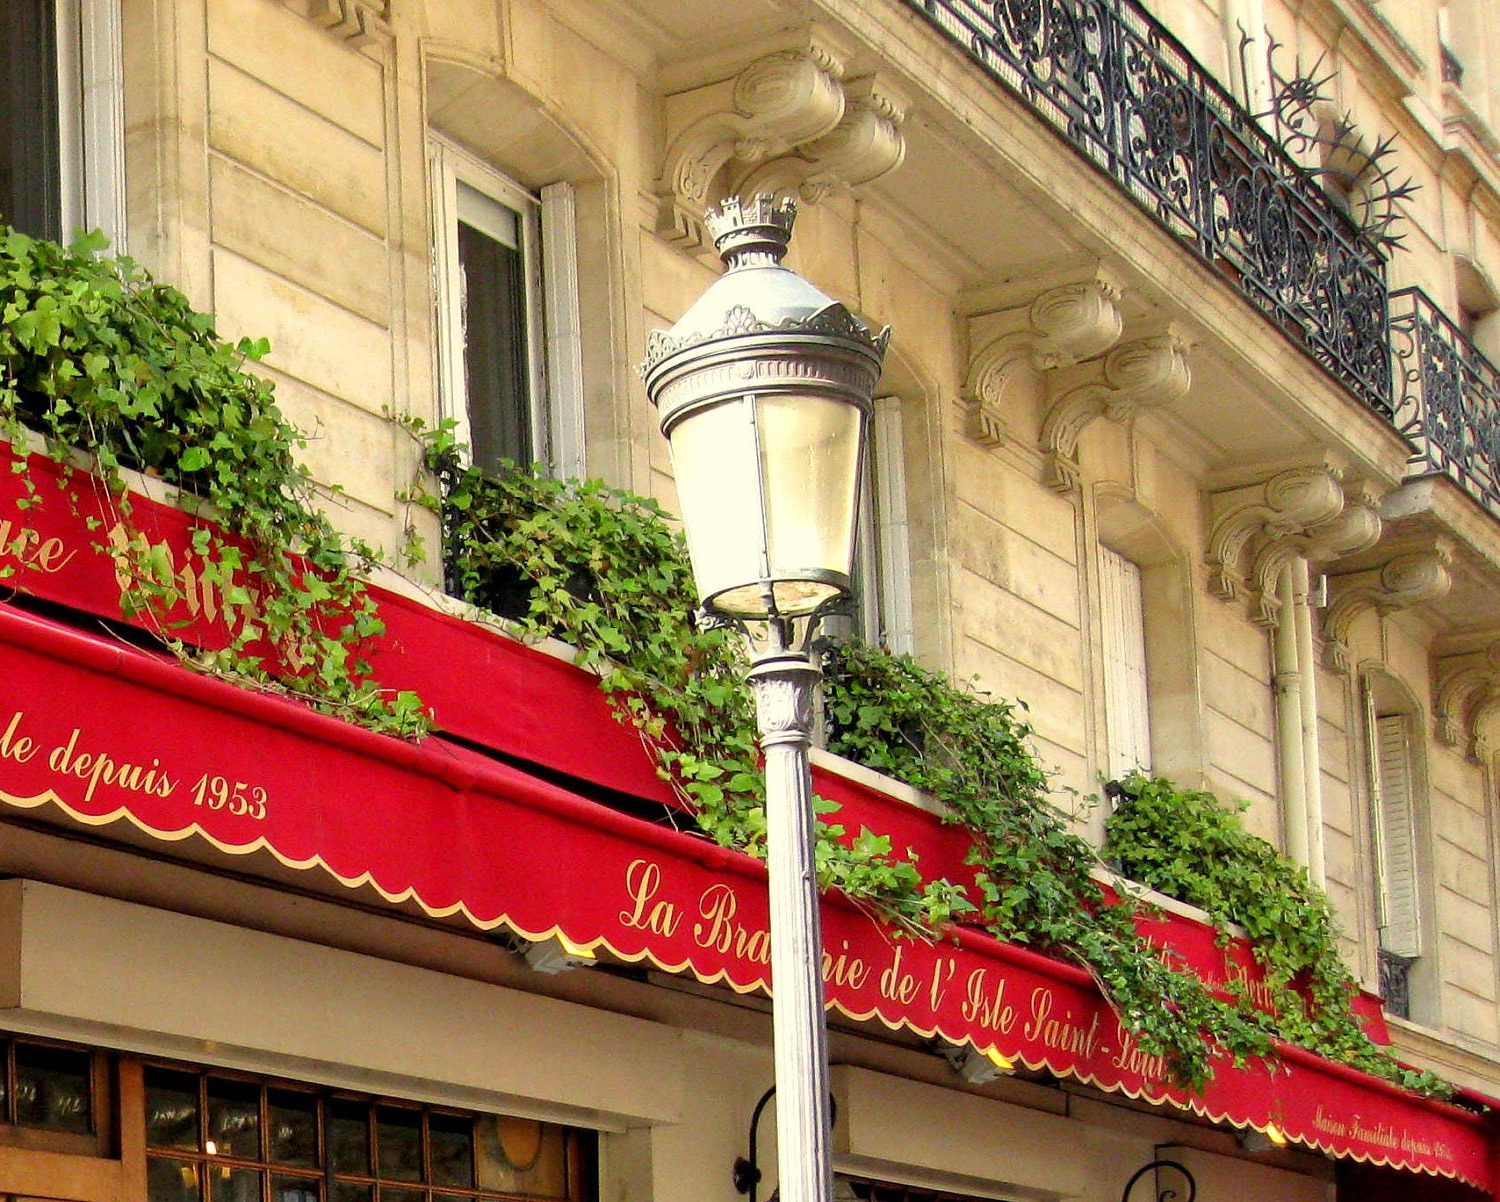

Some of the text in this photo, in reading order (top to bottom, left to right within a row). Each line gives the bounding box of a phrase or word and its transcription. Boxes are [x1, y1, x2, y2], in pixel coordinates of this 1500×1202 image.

[49, 729, 180, 802] depuis
[191, 773, 268, 820] 1953
[619, 859, 683, 937] La
[694, 884, 871, 990] Brarie
[880, 946, 921, 1004] de
[1312, 1104, 1346, 1136] Maison
[1349, 1114, 1399, 1150] Familiale
